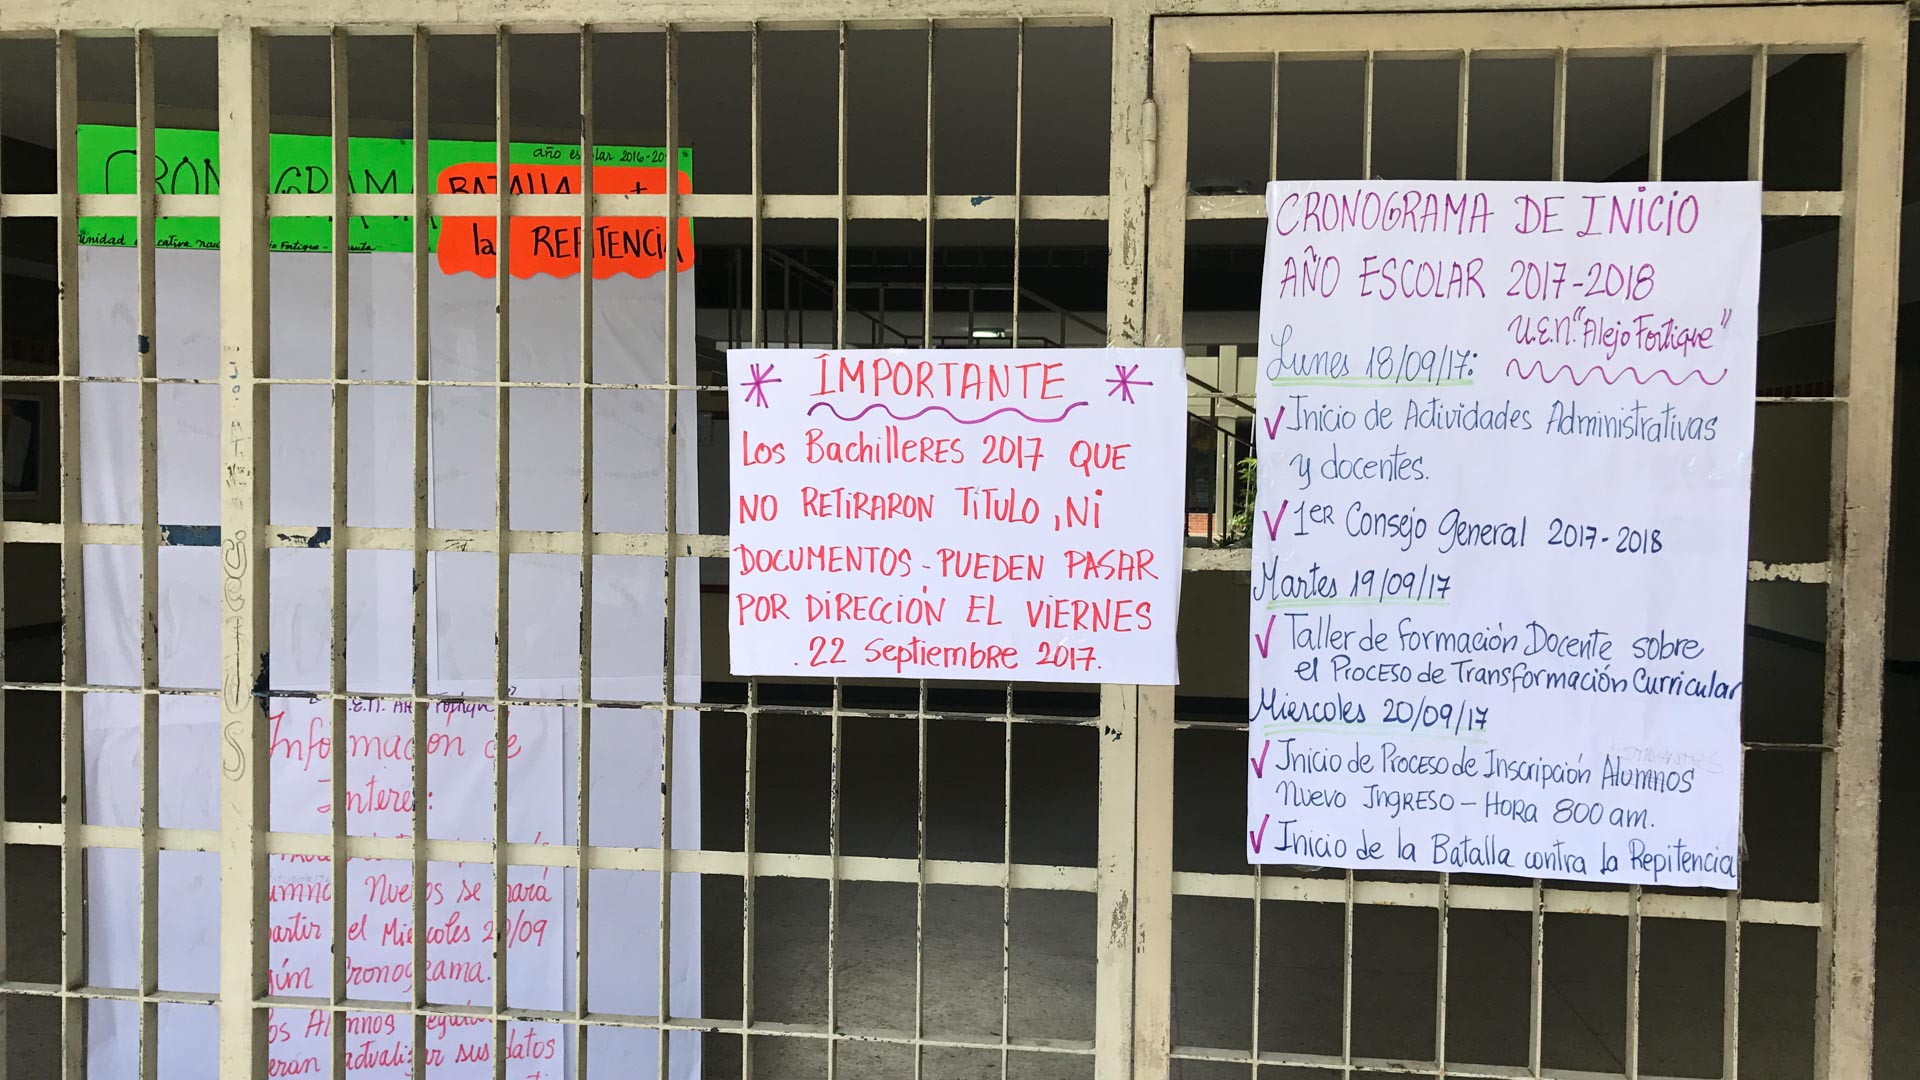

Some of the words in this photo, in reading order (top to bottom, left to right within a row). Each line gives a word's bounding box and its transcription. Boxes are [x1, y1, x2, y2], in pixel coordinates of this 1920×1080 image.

[533, 147, 561, 159] año
[570, 149, 614, 162] eslar
[1277, 189, 1494, 236] CRONOGRAMA
[1514, 195, 1564, 234] DE
[1280, 245, 1340, 299] AÑO
[1359, 255, 1485, 300] ESCOLAR
[1267, 324, 1349, 381] Lunes
[810, 354, 1065, 399] IMPORTANTE
[1287, 395, 1356, 431] Inicio
[1365, 399, 1392, 430] de
[1405, 399, 1532, 433] Actividades
[1546, 400, 1718, 442] Administrativas
[983, 435, 1044, 471] 2017
[1070, 440, 1131, 477] QUE
[1290, 454, 1311, 490] y
[1321, 443, 1429, 481] docentes.
[739, 494, 778, 524] NO
[1346, 501, 1427, 551] Consejo
[734, 545, 912, 578] DOCUMENTOS
[937, 549, 1044, 582] PUEDEN
[1064, 549, 1158, 582] PASAR
[1253, 555, 1337, 601] Martes
[1350, 563, 1451, 603] 19/09/17
[738, 593, 790, 626] POR
[969, 595, 1002, 626] EL
[1284, 613, 1356, 650] Taller
[1359, 618, 1388, 651] de
[1524, 621, 1612, 660] Docente
[1294, 657, 1318, 682] el
[1418, 661, 1446, 684] de
[1633, 667, 1742, 700] Curricular
[1249, 687, 1366, 723] Miercoles
[1383, 695, 1488, 735] 20/09/17
[1275, 738, 1342, 774] Inicio
[1348, 742, 1374, 773] de
[1452, 745, 1478, 778] de
[1483, 749, 1591, 789] Inscripción
[317, 775, 433, 814] ntere:
[1553, 799, 1604, 825] 800
[1610, 807, 1655, 829] am.
[1274, 819, 1347, 858] Inicio
[1356, 829, 1384, 860] de
[1398, 827, 1416, 862] la
[1433, 833, 1512, 867] Batalla
[1525, 840, 1587, 875] contra
[1629, 838, 1736, 882] Repitencia
[365, 874, 443, 905] Nueos
[456, 879, 481, 903] se
[382, 911, 470, 946] Miecoles
[305, 1009, 395, 1039] Almnos
[345, 1040, 444, 1077] actualiar
[455, 1043, 489, 1063] sus
